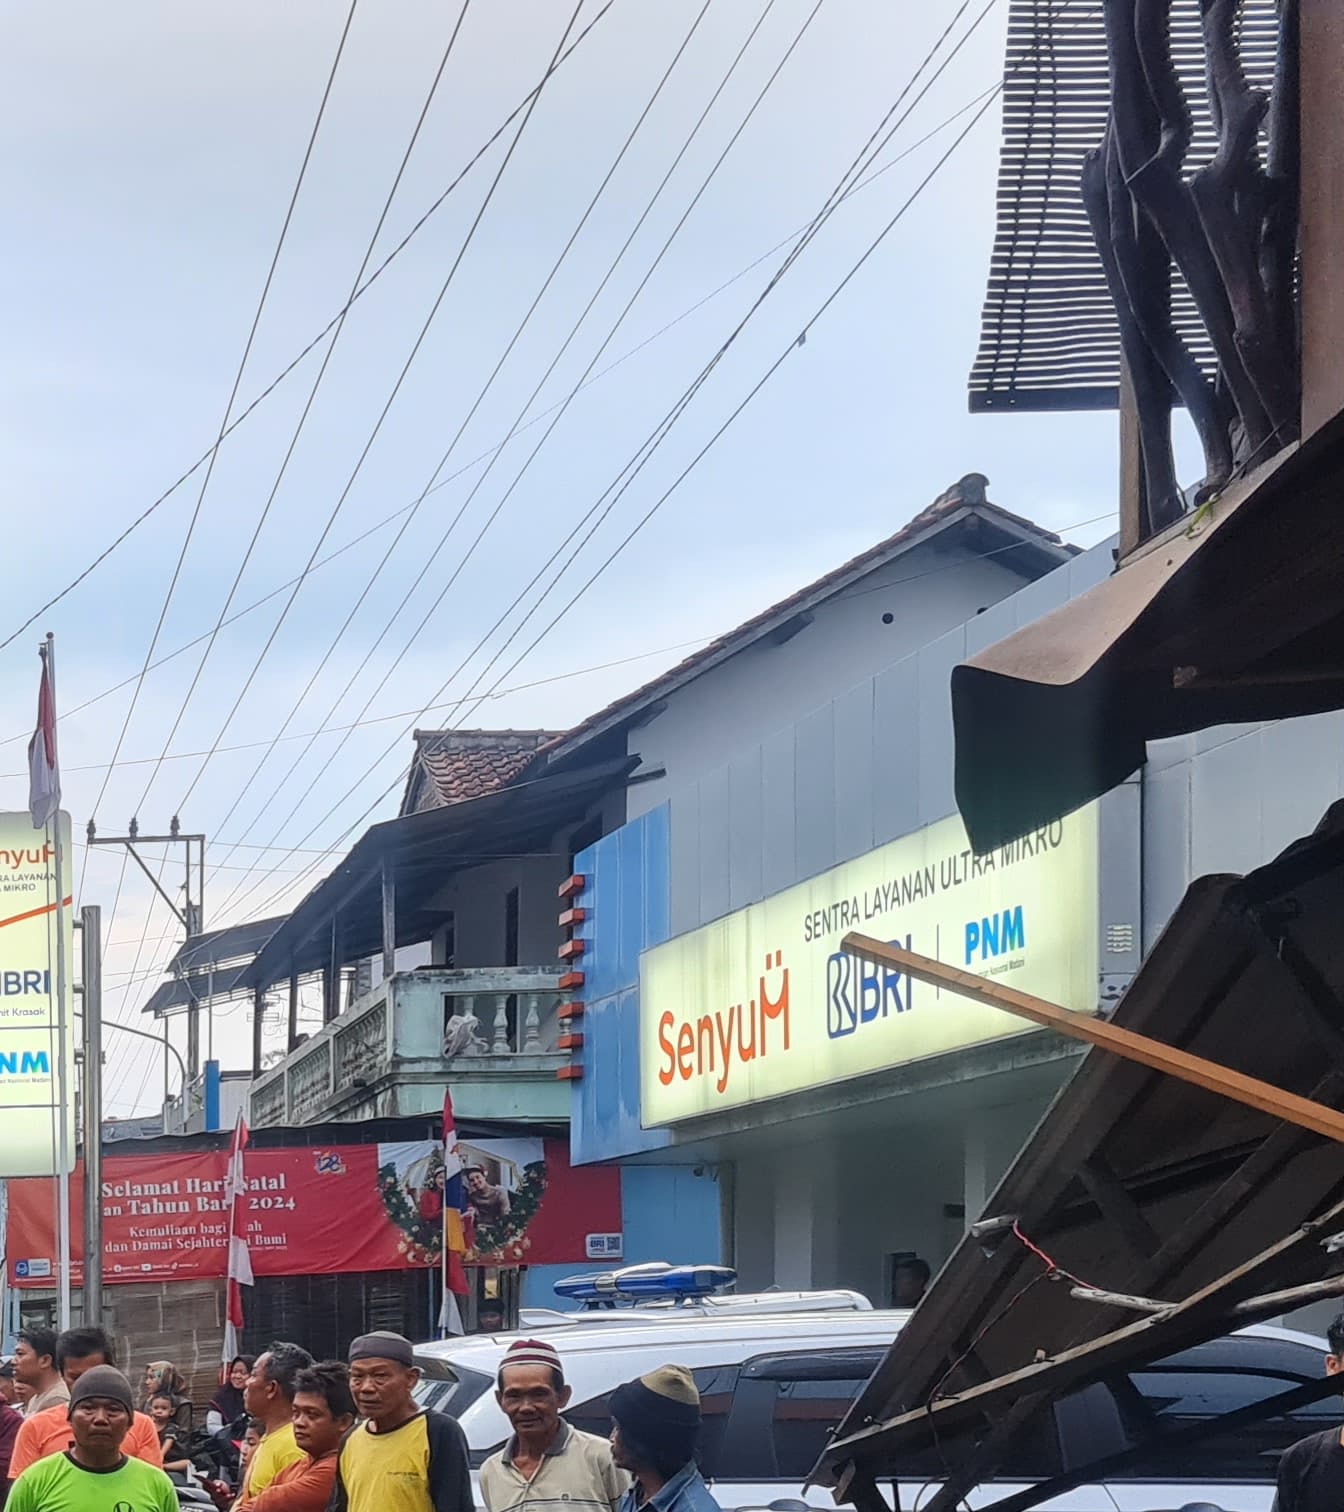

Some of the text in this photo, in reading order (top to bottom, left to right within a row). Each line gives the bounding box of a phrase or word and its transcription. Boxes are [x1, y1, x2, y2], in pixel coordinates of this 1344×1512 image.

[12, 871, 57, 881] LAYANAN
[804, 816, 1063, 943] SENTRA LAYANAN ULTRA MIKRO
[4, 883, 36, 892] MIKRO
[965, 905, 1025, 965] PNM
[4, 969, 51, 996] BRI
[860, 934, 912, 1024] BRI
[12, 1007, 46, 1017] Krasak
[101, 1180, 180, 1198] Selamat
[243, 1172, 286, 1192] atal
[103, 1195, 296, 1217] an Tahun Bar 2024
[129, 1221, 227, 1238] Kemuliaan bagi
[104, 1241, 129, 1253] dan
[131, 1238, 173, 1252] Damai
[176, 1235, 229, 1250] Sejahter
[255, 1232, 287, 1246] Bumi
